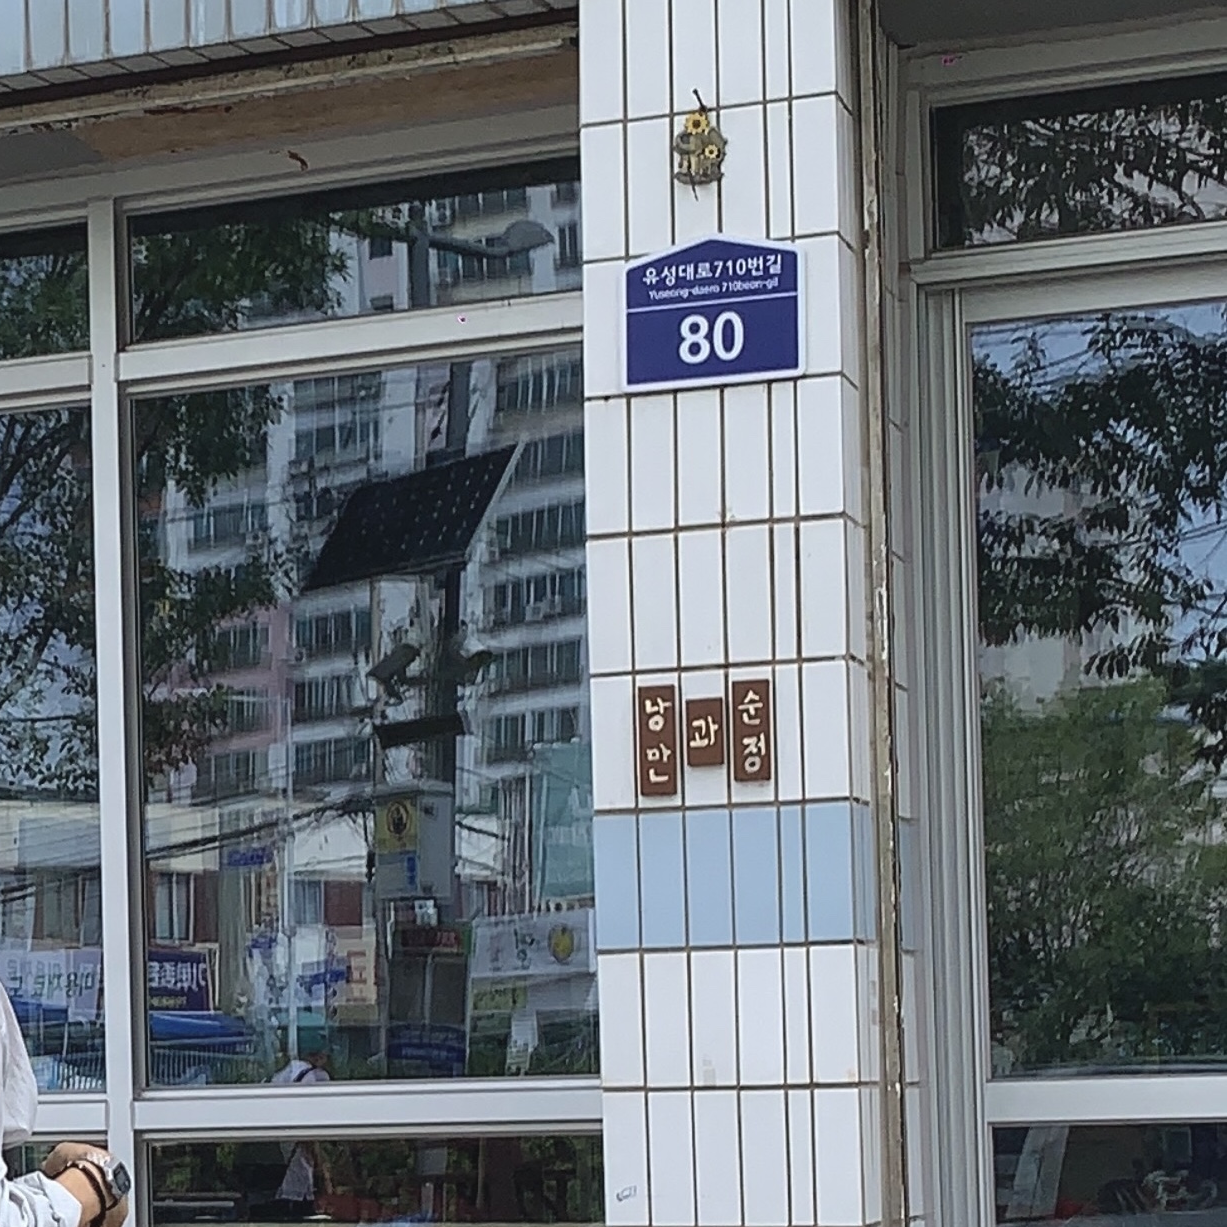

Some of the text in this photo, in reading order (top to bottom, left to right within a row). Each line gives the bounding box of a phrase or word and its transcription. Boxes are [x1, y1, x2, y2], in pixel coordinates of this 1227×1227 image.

[642, 253, 782, 287] 유성대로710번길
[678, 310, 744, 364] 80
[644, 689, 766, 783] 낭만 과 순정
